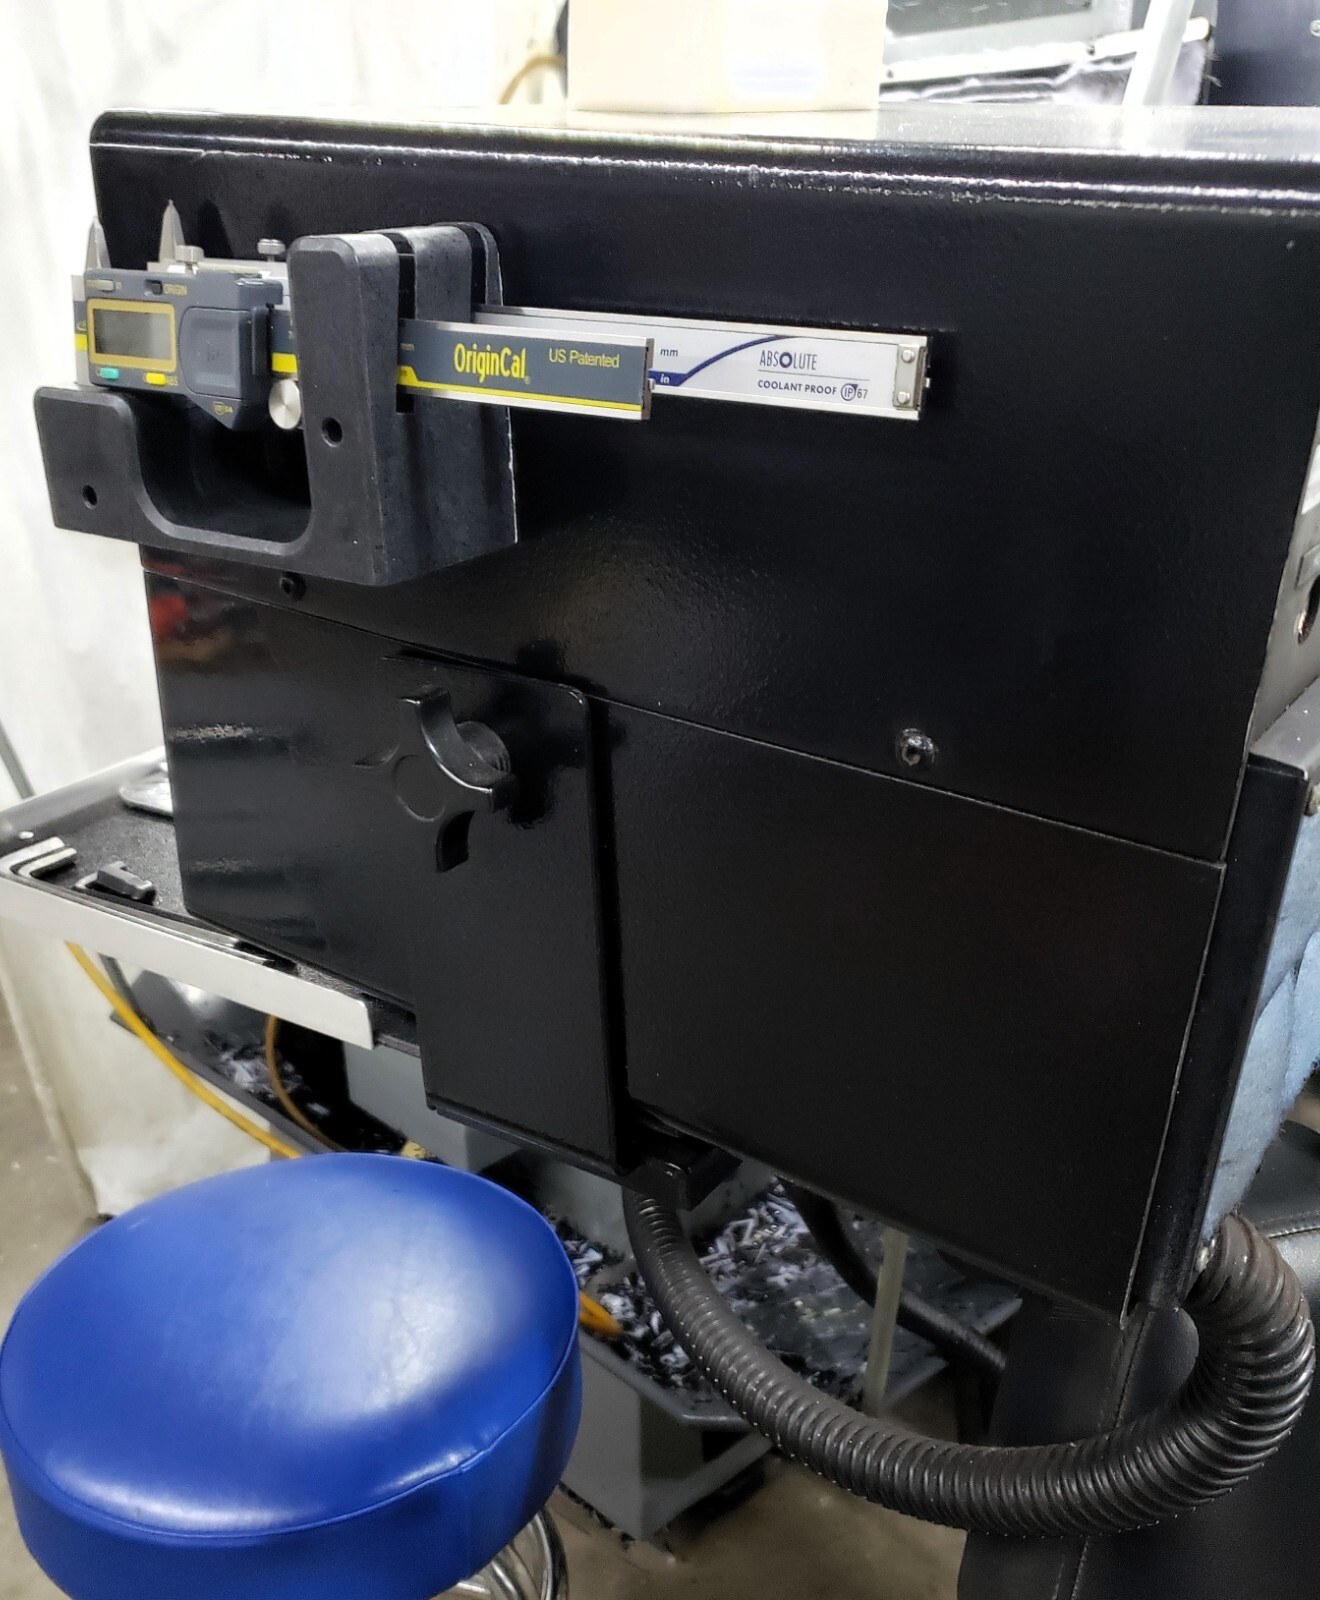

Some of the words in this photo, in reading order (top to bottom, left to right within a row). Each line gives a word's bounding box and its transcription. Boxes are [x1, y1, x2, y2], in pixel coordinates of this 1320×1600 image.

[548, 347, 567, 363] US
[569, 349, 620, 368] Patented
[660, 348, 679, 358] mm
[759, 349, 818, 371] ABSOLUTE
[453, 343, 525, 383] OriginCal
[659, 373, 671, 384] in
[757, 379, 803, 393] COOLANT
[804, 383, 838, 396] PROOF
